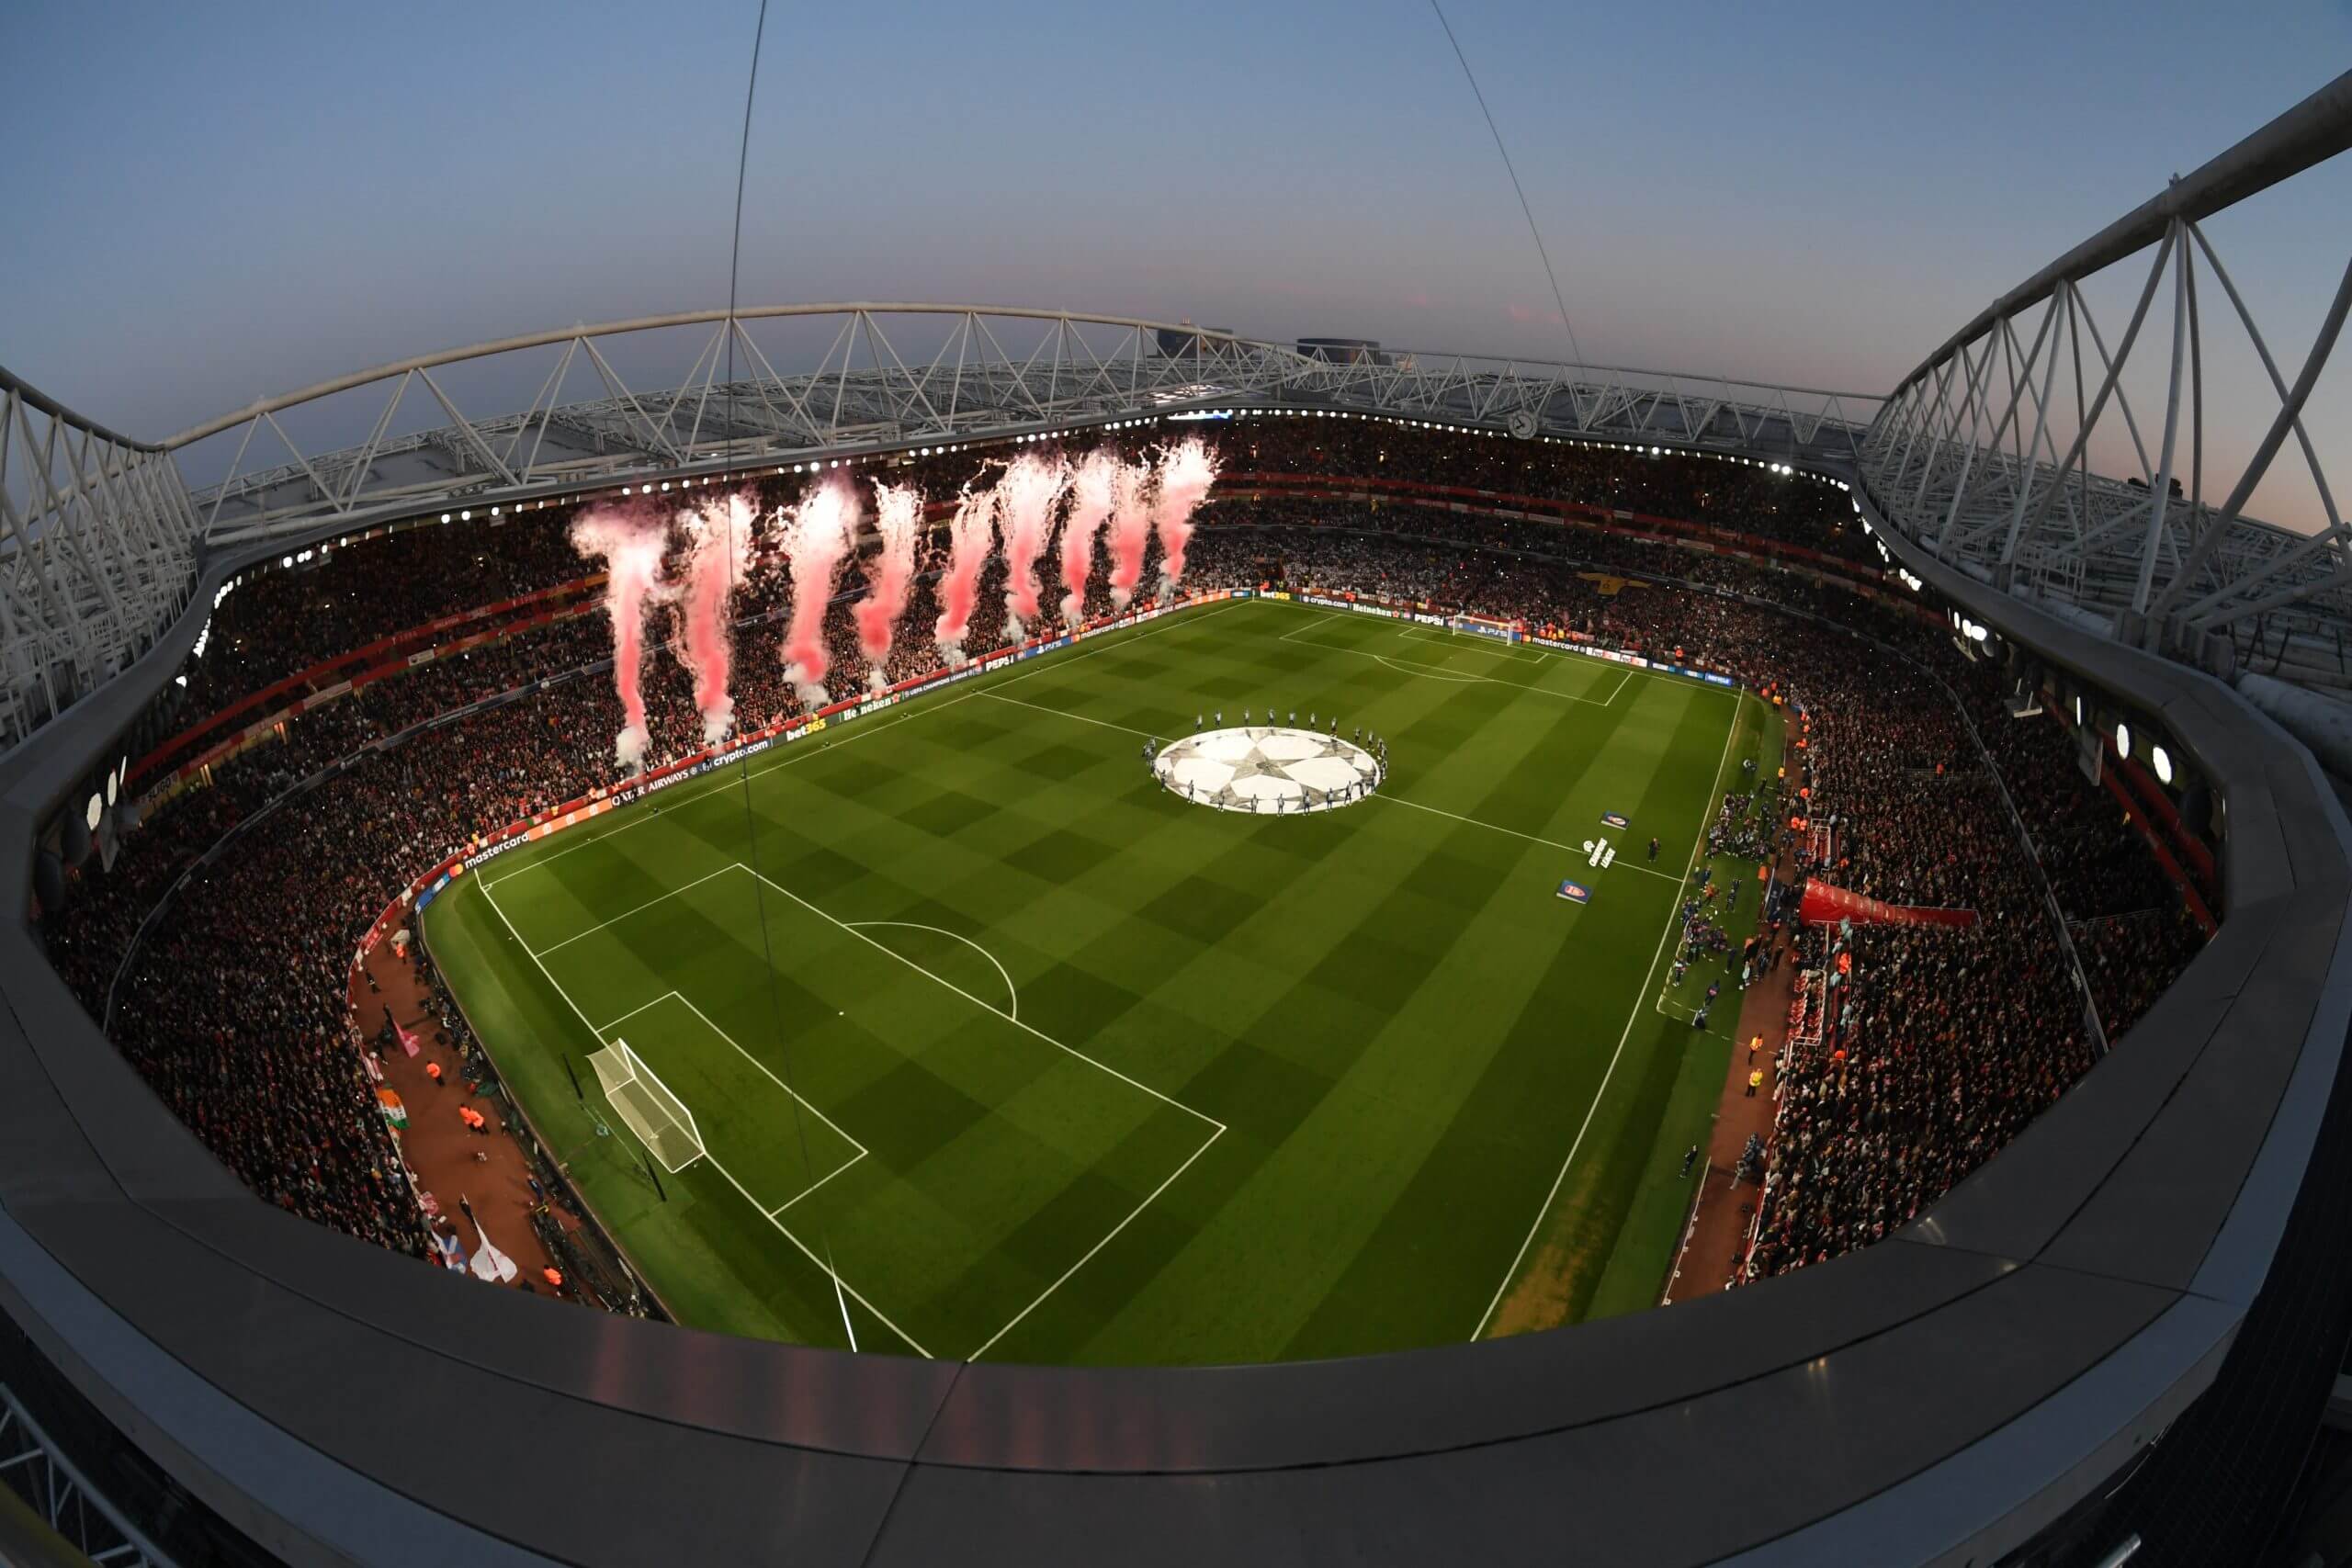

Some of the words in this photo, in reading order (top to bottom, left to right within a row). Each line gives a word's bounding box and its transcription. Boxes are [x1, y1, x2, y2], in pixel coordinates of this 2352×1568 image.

[1260, 590, 1290, 601] bet365
[1310, 596, 1348, 609] crypto.com
[1352, 603, 1392, 617] Heineken
[1415, 613, 1444, 626] PEPSI
[1080, 623, 1115, 640] mastercard
[1532, 637, 1579, 652] mastercard
[985, 655, 1014, 672] PEPSI
[842, 697, 892, 722] Heneken
[786, 718, 827, 742] bet365
[713, 739, 768, 768] crypto.com
[648, 769, 689, 793] AIRWAYS
[465, 831, 529, 869] mastercard
